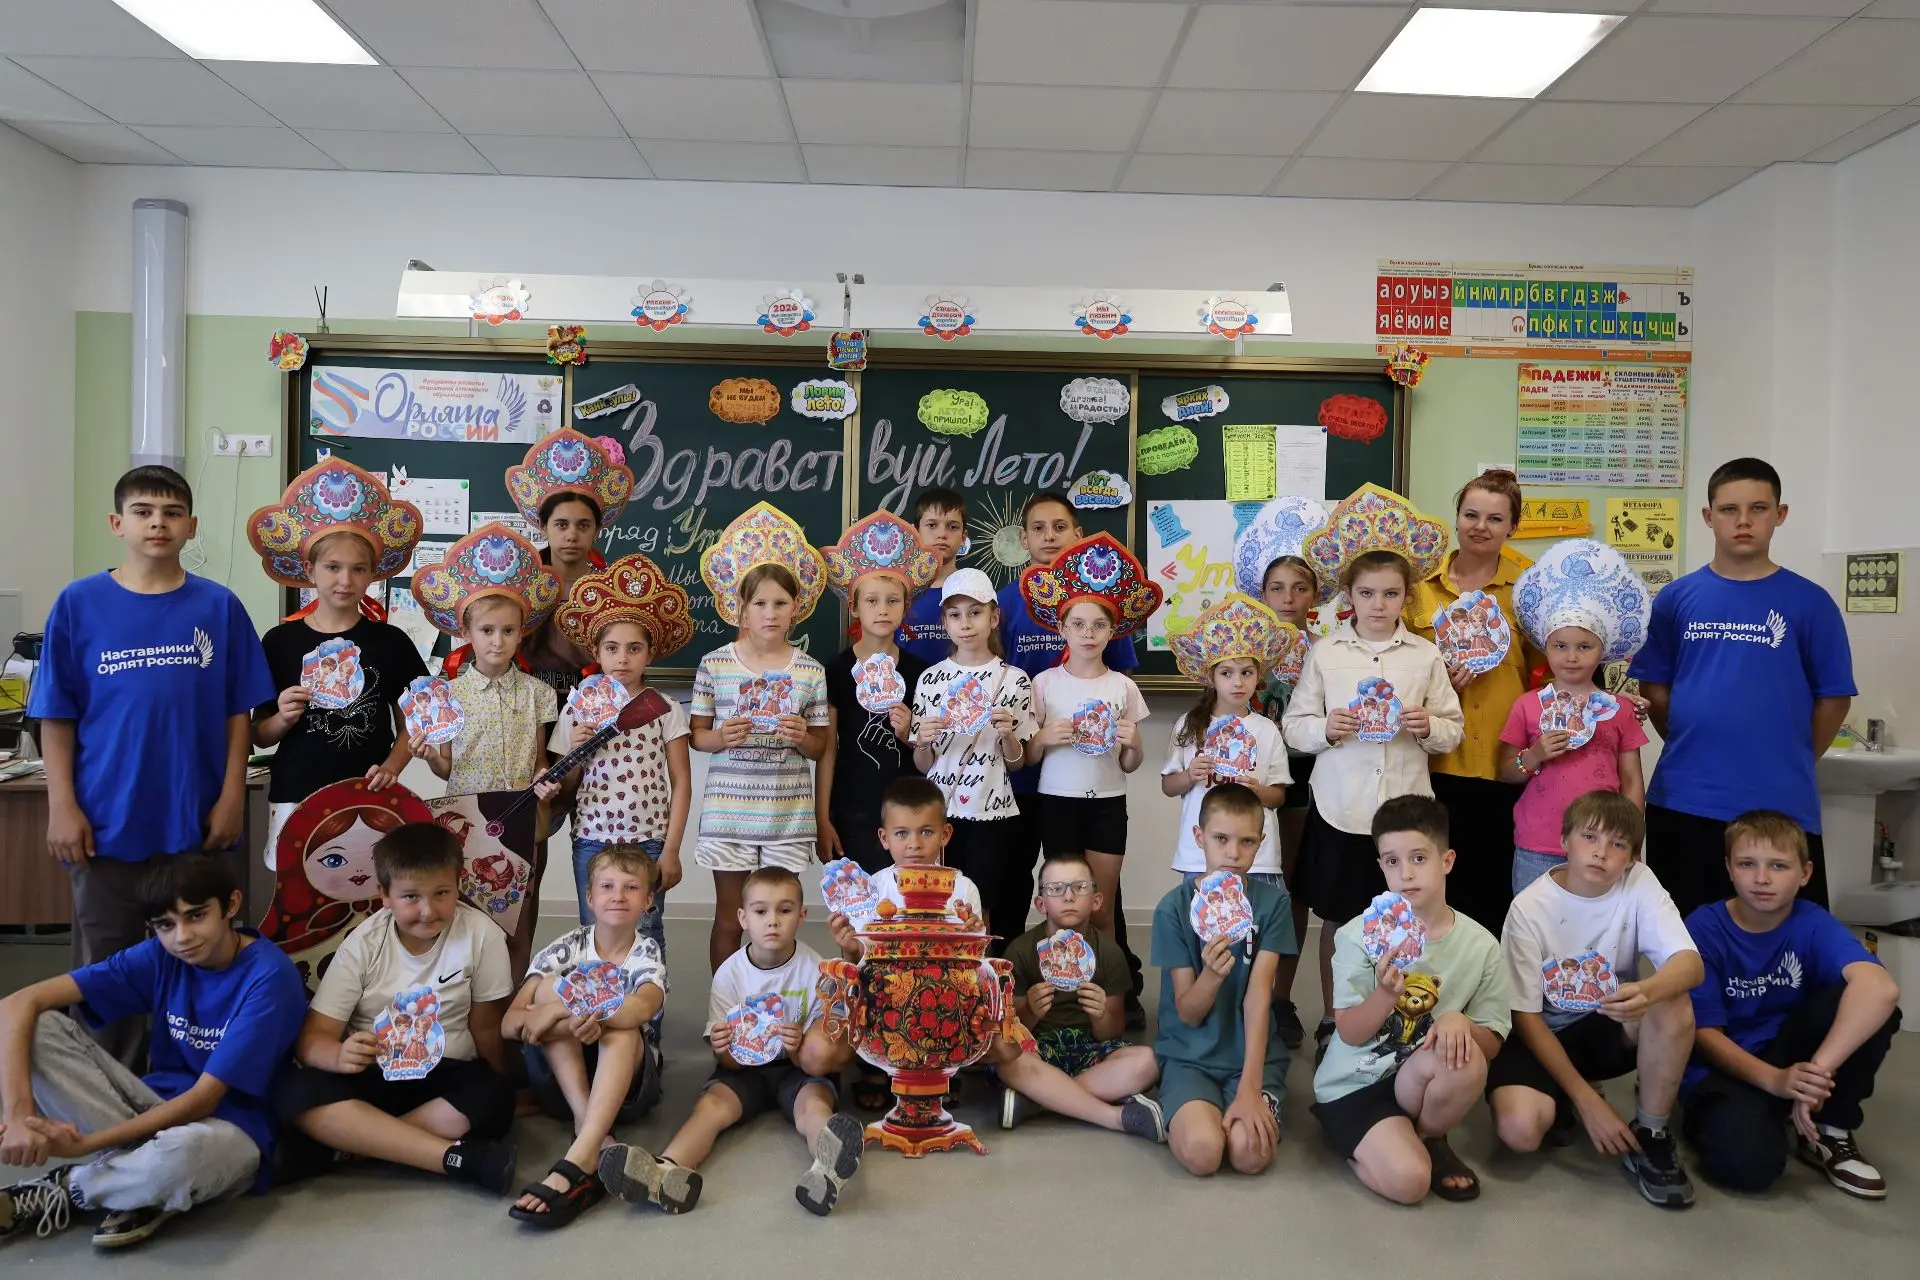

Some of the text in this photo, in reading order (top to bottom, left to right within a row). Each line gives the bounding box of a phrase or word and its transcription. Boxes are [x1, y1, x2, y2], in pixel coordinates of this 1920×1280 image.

[773, 304, 798, 312] 2026
[1532, 369, 1600, 383] ПАДЕЖИ
[375, 372, 500, 434] Орлята
[1079, 404, 1121, 413] РАДОСТЬ!
[407, 421, 499, 442] РОССИИ
[622, 400, 844, 510] Здравст
[963, 414, 1093, 489] Лето!
[1688, 622, 1766, 632] Наставники
[1018, 634, 1066, 643] Наставни
[1684, 631, 1771, 644] Орлят России
[101, 644, 195, 662] Наставники
[1017, 643, 1044, 653] Орлят
[1458, 650, 1489, 661] День
[97, 656, 200, 675] Орлят России
[1565, 991, 1594, 1000] День
[391, 1060, 419, 1070] День
